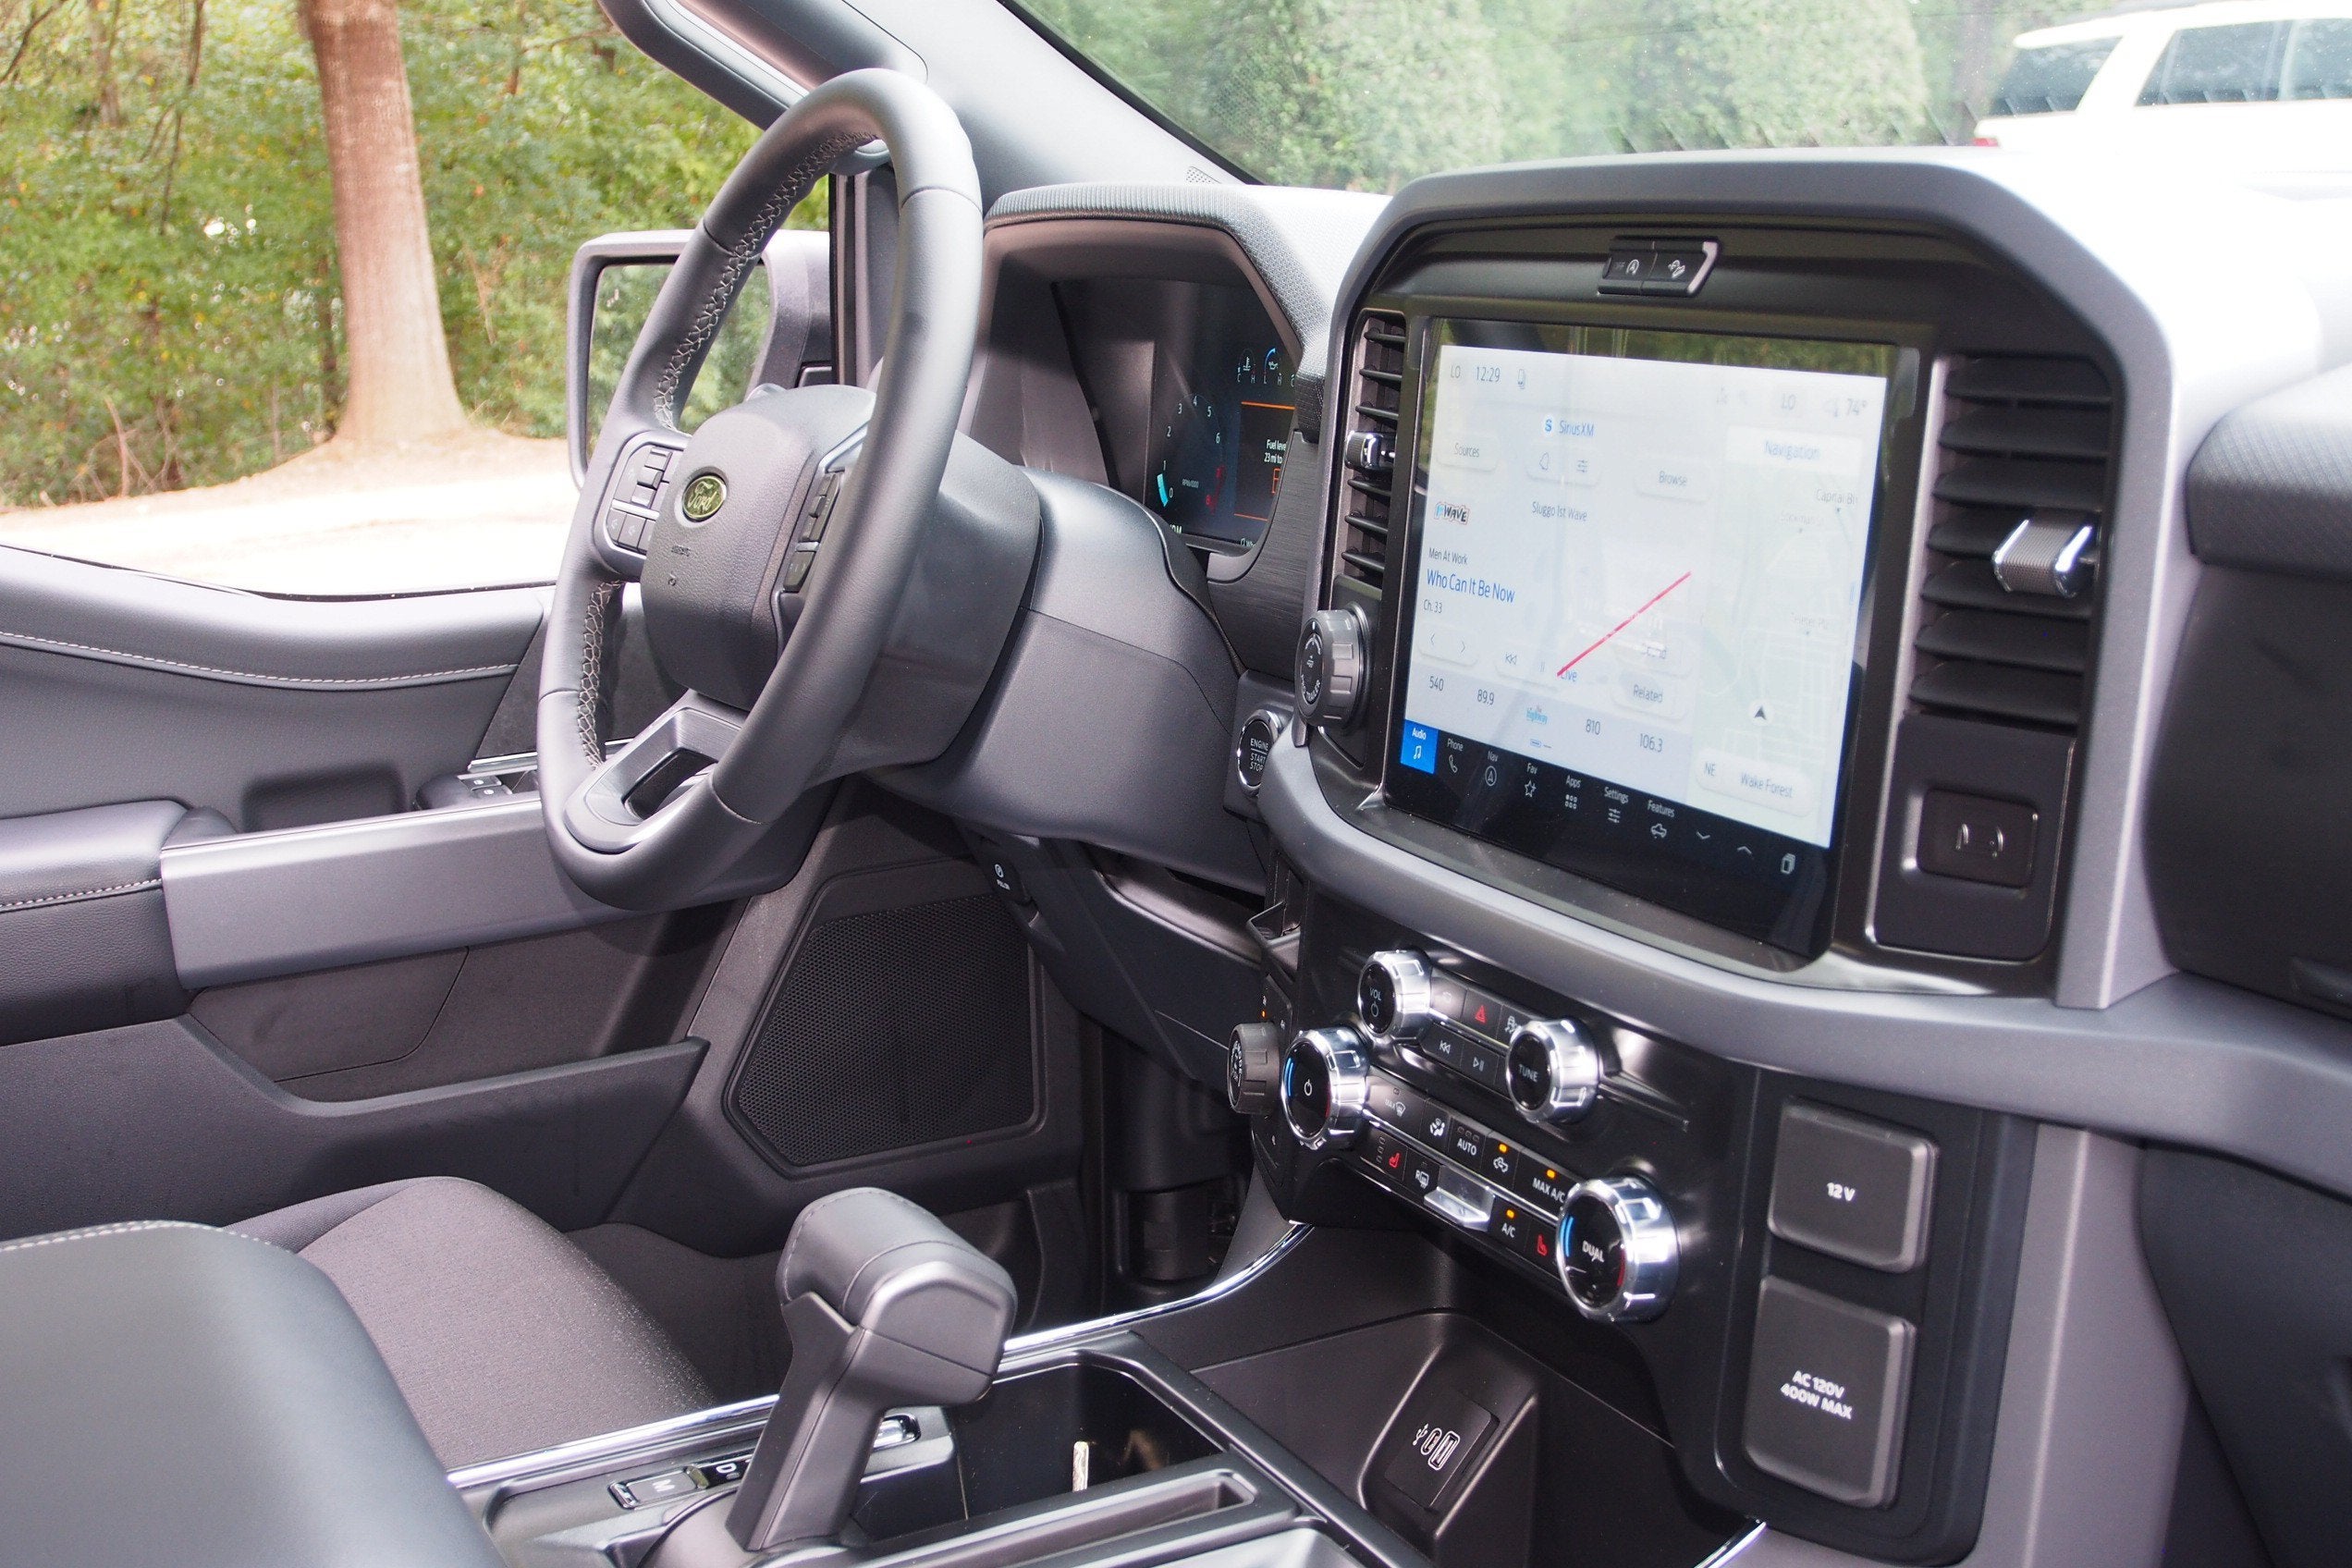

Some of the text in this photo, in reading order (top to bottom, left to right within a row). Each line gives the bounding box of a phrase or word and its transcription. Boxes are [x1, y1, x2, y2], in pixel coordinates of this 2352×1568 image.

[1476, 365, 1501, 383] 12:29
[1178, 403, 1182, 414] 3
[1193, 395, 1197, 406] 4
[1207, 406, 1212, 417] 5
[1167, 426, 1171, 437] 2
[1559, 420, 1595, 436] SiriusXM
[1216, 432, 1220, 444] 6
[1266, 439, 1287, 451] Fuel leve
[1264, 452, 1270, 462] 23
[1454, 442, 1480, 458] Sources
[1764, 439, 1821, 460] Navigation
[1659, 469, 1688, 486] Browse
[687, 481, 717, 513] Ford
[1532, 501, 1555, 518] Sluggo
[1568, 508, 1587, 522] Wave
[1428, 547, 1468, 565] Men At Work
[1427, 569, 1515, 603] Who Can It Be Now
[1428, 677, 1443, 692] 540
[1477, 689, 1495, 705] 89.9
[1633, 684, 1663, 703] Related
[1412, 728, 1427, 740] Audio
[1586, 719, 1601, 735] 810
[1250, 738, 1268, 752] ENGINE
[1447, 739, 1464, 753] Phone
[1639, 732, 1663, 753] 106.3
[1250, 753, 1267, 763] START
[1249, 761, 1264, 772] STOP
[1526, 762, 1538, 775] Fav
[1704, 762, 1717, 777] NE
[1565, 775, 1582, 789] Apps
[1740, 772, 1794, 798] Wake Forest
[1604, 787, 1629, 805] Settings
[1647, 800, 1675, 818] Features
[1370, 986, 1382, 1001] VOL
[1518, 1063, 1538, 1083] TUNE
[1457, 1138, 1477, 1156] AUTO
[1532, 1177, 1566, 1204] MAX A/C
[1501, 1221, 1516, 1238] A/C
[1582, 1241, 1605, 1263] DUAL
[1792, 1370, 1845, 1399] AC 120V
[1781, 1383, 1853, 1420] 400W MAX
